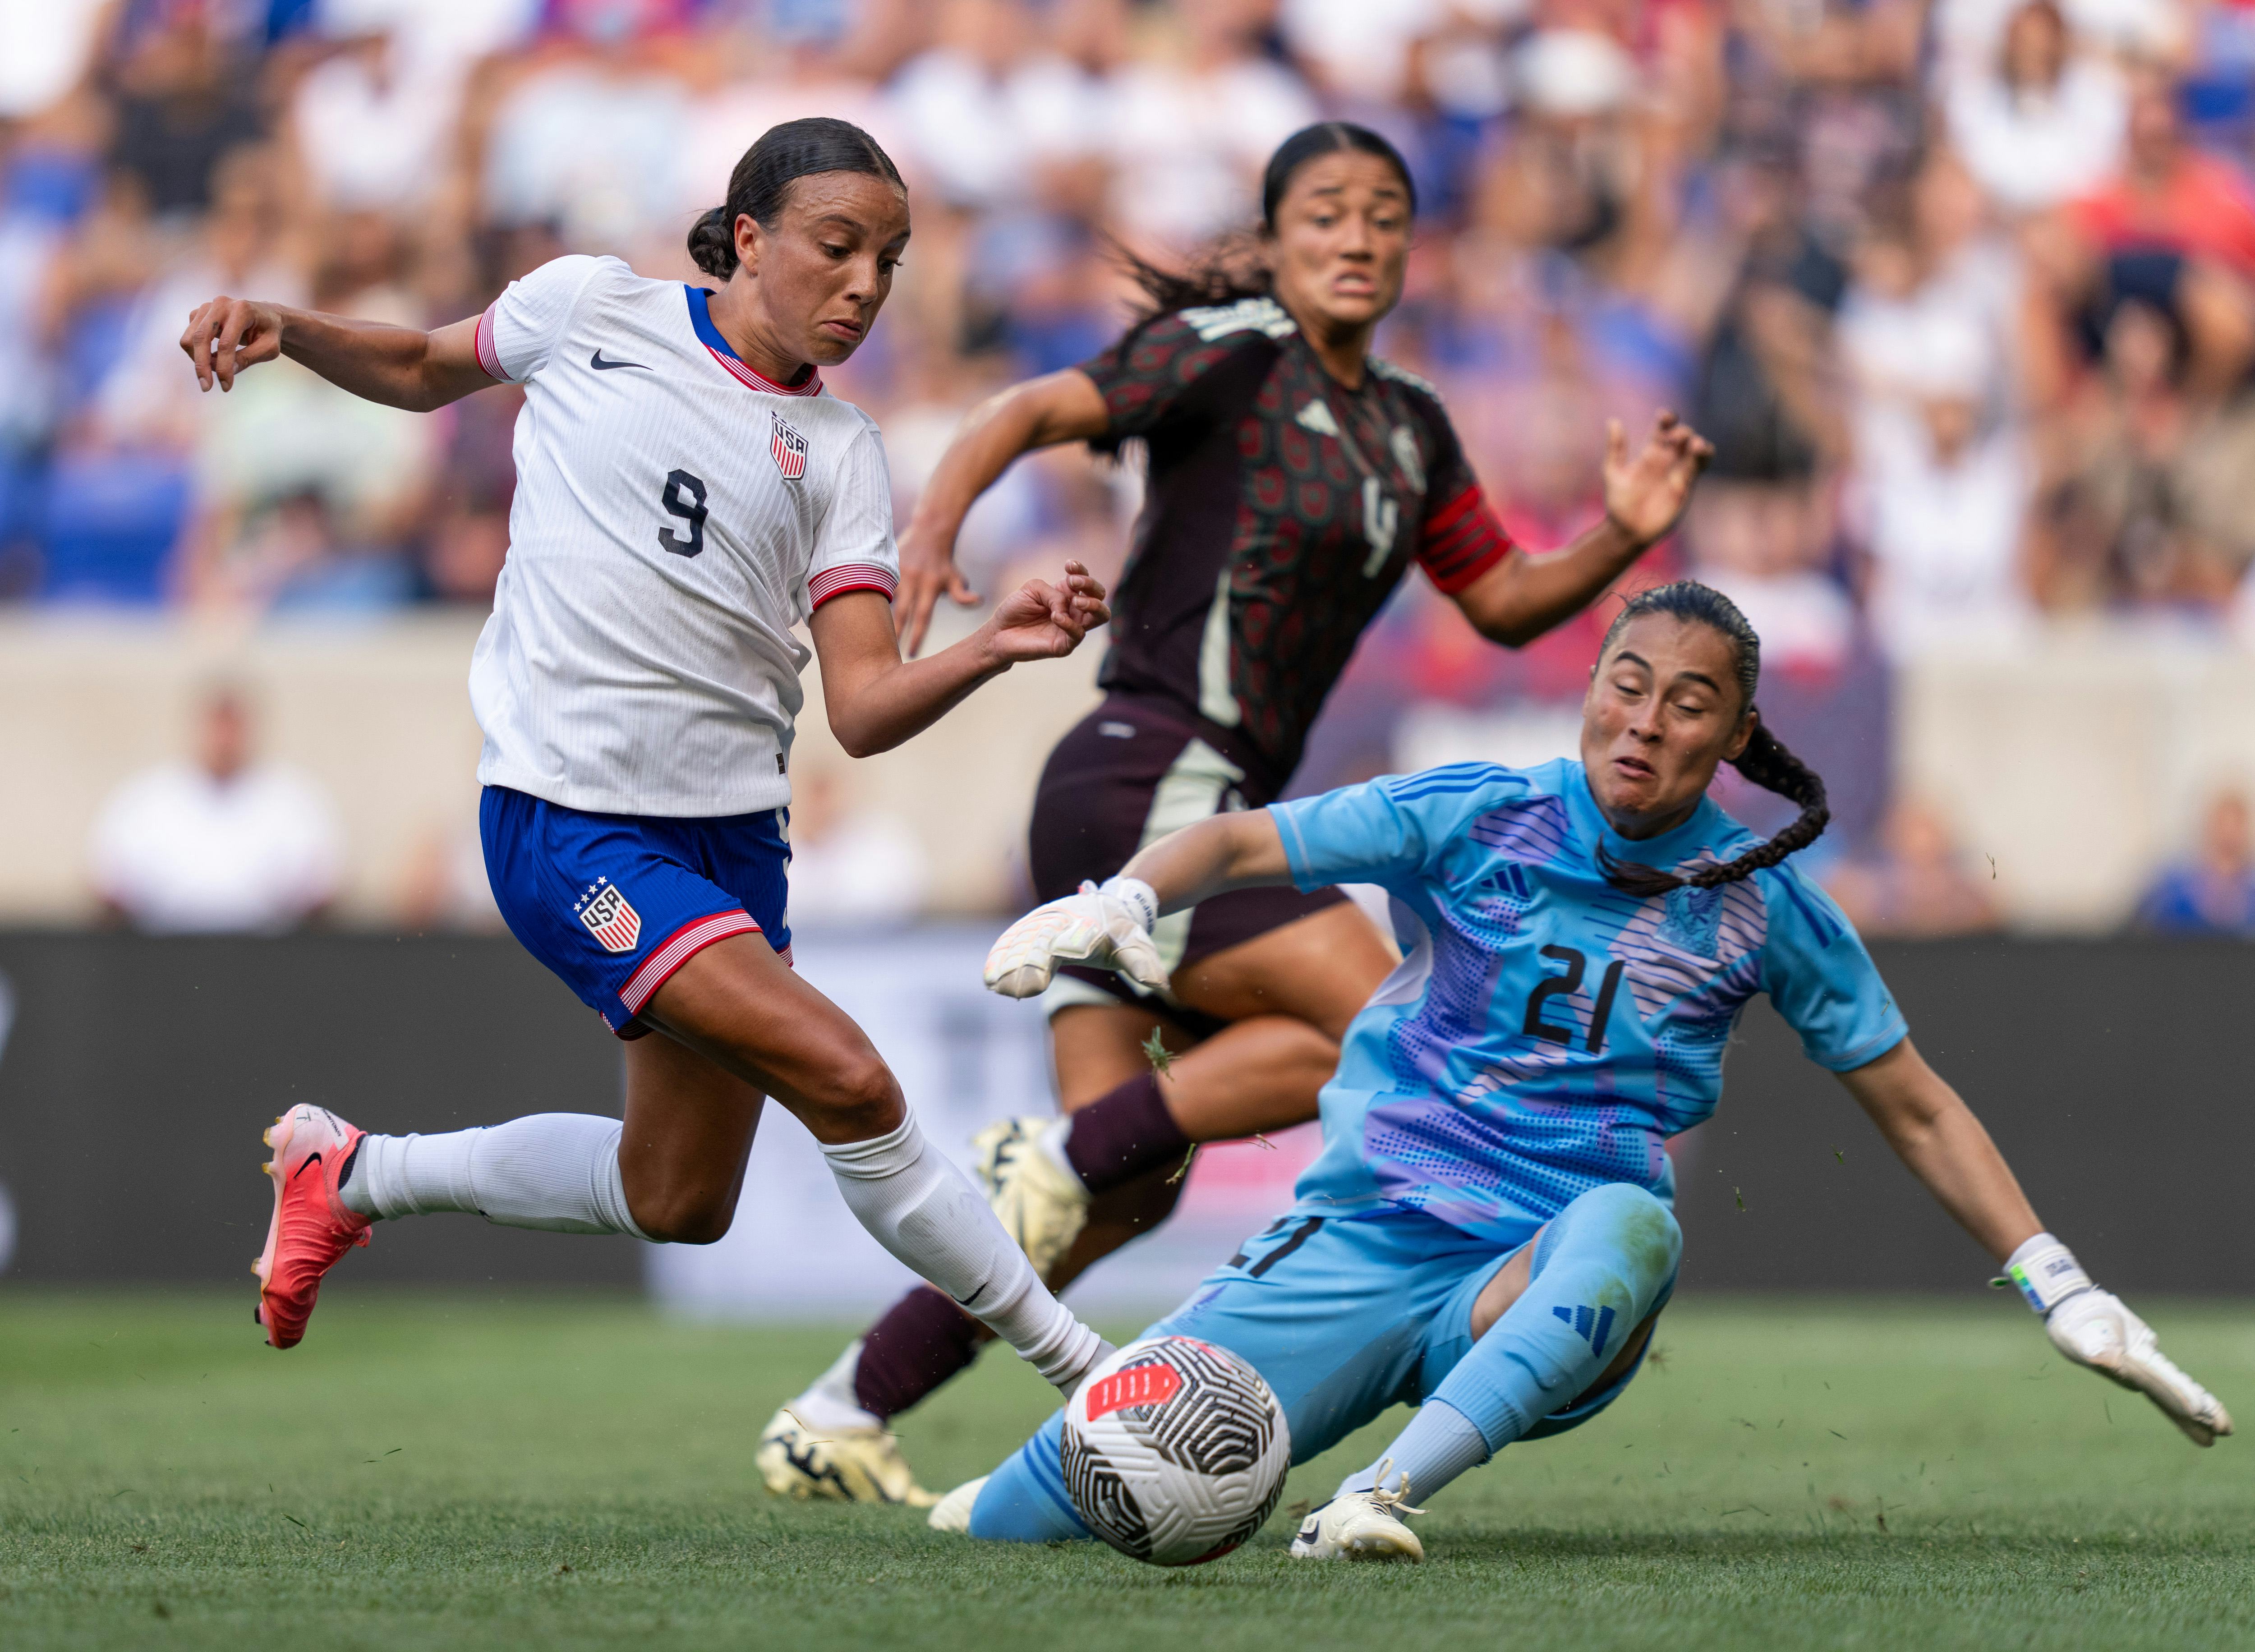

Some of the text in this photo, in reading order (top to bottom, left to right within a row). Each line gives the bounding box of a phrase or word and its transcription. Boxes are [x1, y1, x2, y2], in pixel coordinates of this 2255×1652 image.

[775, 422, 805, 454] USA
[658, 468, 709, 559] 9
[1362, 476, 1398, 578] 4
[584, 888, 620, 928] USA
[1523, 944, 1626, 1054] 21
